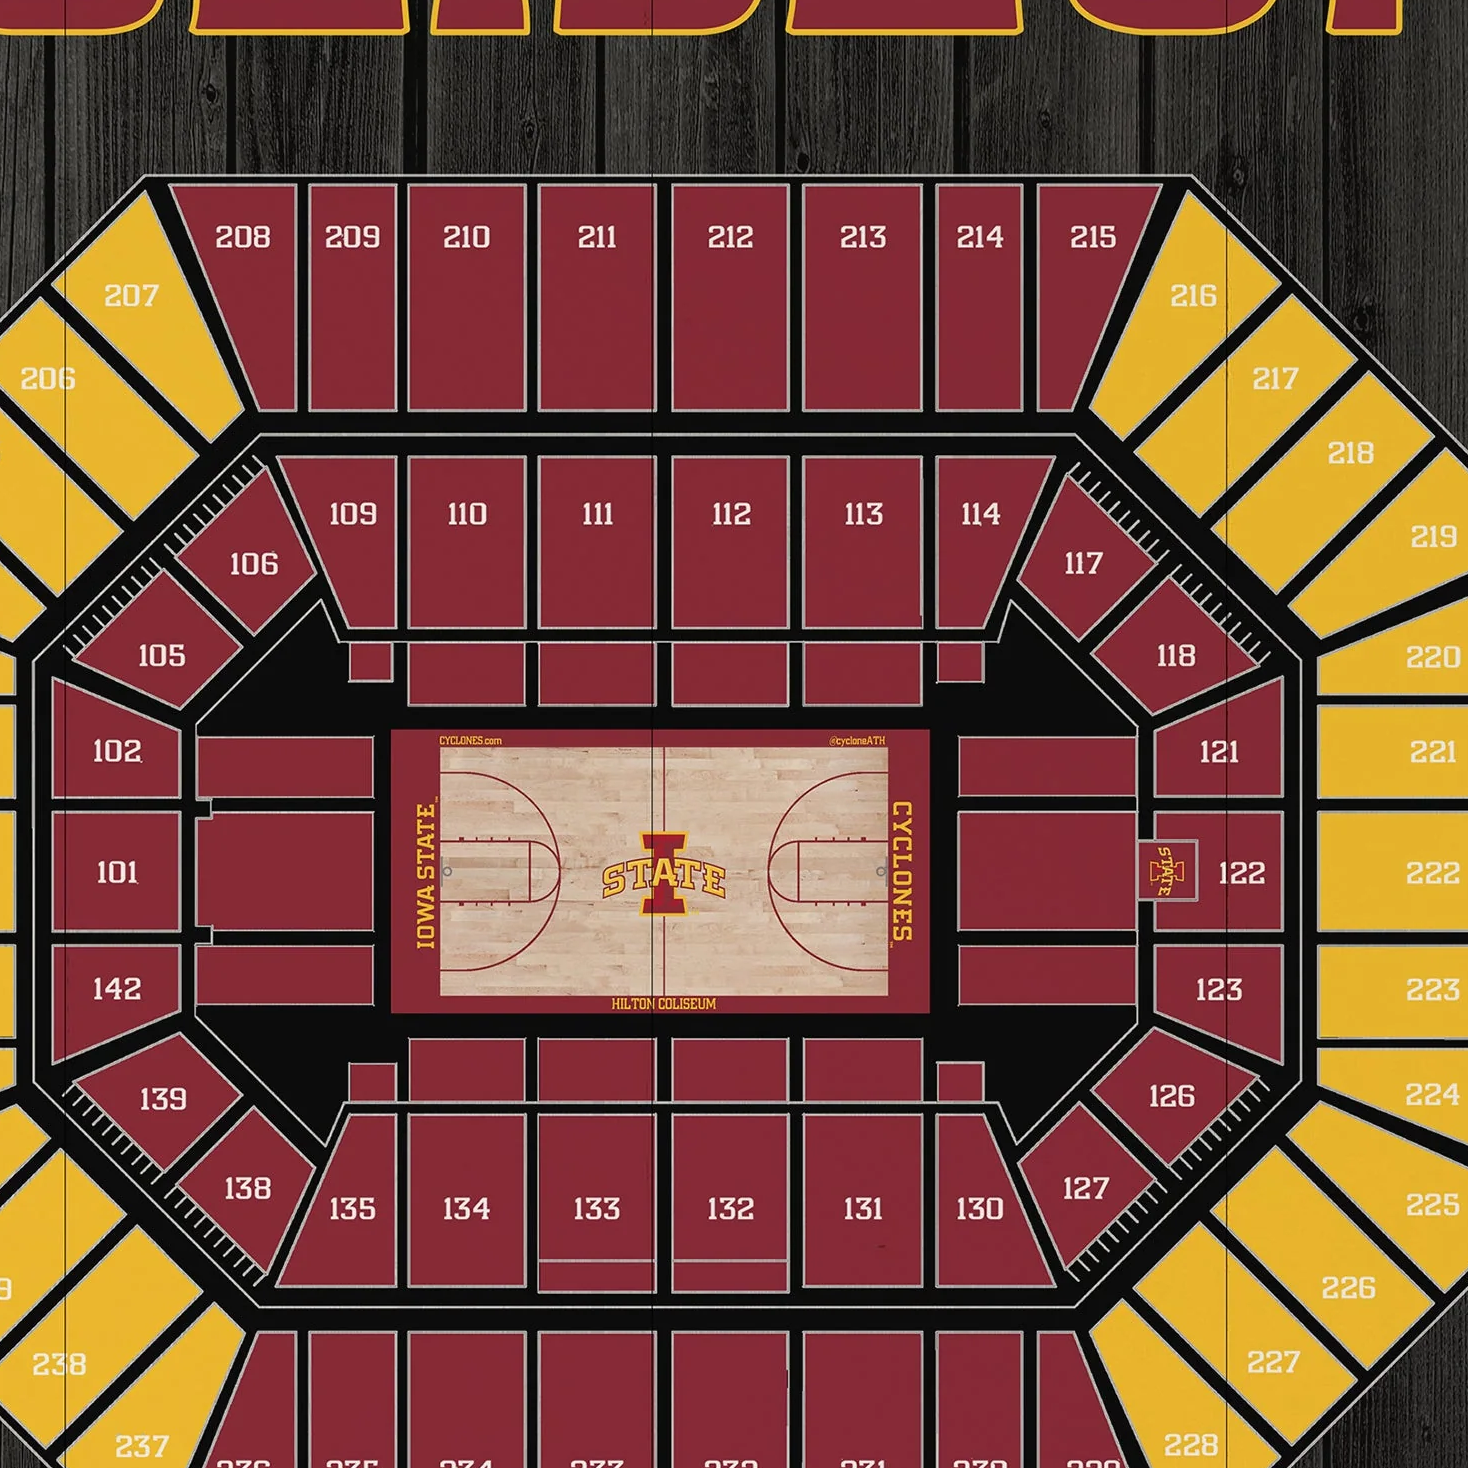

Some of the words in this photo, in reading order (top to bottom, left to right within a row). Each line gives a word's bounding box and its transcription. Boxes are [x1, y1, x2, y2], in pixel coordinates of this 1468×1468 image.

[215, 225, 271, 249] 208
[325, 225, 380, 249] 209
[443, 225, 490, 249] 210
[578, 225, 617, 249] 211
[708, 225, 754, 249] 212
[840, 225, 887, 249] 213
[957, 225, 1004, 249] 214
[1070, 225, 1117, 249] 215
[104, 283, 160, 307] 207
[1171, 283, 1217, 307] 216
[21, 366, 76, 390] 206
[1253, 366, 1300, 390] 217
[1328, 441, 1374, 464] 218
[330, 502, 377, 526] 109
[448, 502, 487, 526] 110
[583, 502, 614, 526] 111
[713, 502, 751, 526] 112
[845, 502, 883, 526] 113
[962, 502, 1001, 527] 114
[1411, 524, 1458, 548] 219
[230, 552, 279, 576] 106
[1065, 551, 1104, 575] 117
[139, 643, 186, 667] 105
[1157, 643, 1196, 667] 118
[1406, 645, 1461, 669] 220
[93, 739, 142, 763] 102
[1200, 740, 1239, 763] 121
[1410, 740, 1456, 764] 221
[416, 804, 435, 880] STATE
[97, 861, 138, 884] 101
[602, 857, 727, 900] STATE
[892, 801, 913, 941] CYCLONES
[1219, 861, 1266, 885] 122
[1406, 861, 1460, 884] 222
[416, 885, 435, 949] IOWA
[93, 977, 141, 1000] 142
[1196, 977, 1243, 1001] 123
[1406, 978, 1460, 1001] 223
[611, 997, 655, 1010] HILTON
[658, 997, 717, 1010] COLISEUM
[140, 1087, 187, 1111] 139
[1149, 1084, 1195, 1108] 126
[1405, 1082, 1460, 1106] 224
[225, 1176, 272, 1200] 138
[1063, 1176, 1110, 1200] 127
[330, 1197, 376, 1220] 135
[443, 1197, 491, 1220] 134
[574, 1196, 620, 1220] 133
[708, 1197, 754, 1220] 132
[844, 1196, 883, 1220] 131
[957, 1197, 1004, 1220] 130
[1406, 1193, 1460, 1216] 225
[1322, 1276, 1376, 1299] 226
[32, 1352, 87, 1376] 238
[1247, 1350, 1301, 1374] 227
[115, 1434, 170, 1458] 237
[1164, 1433, 1219, 1457] 228
